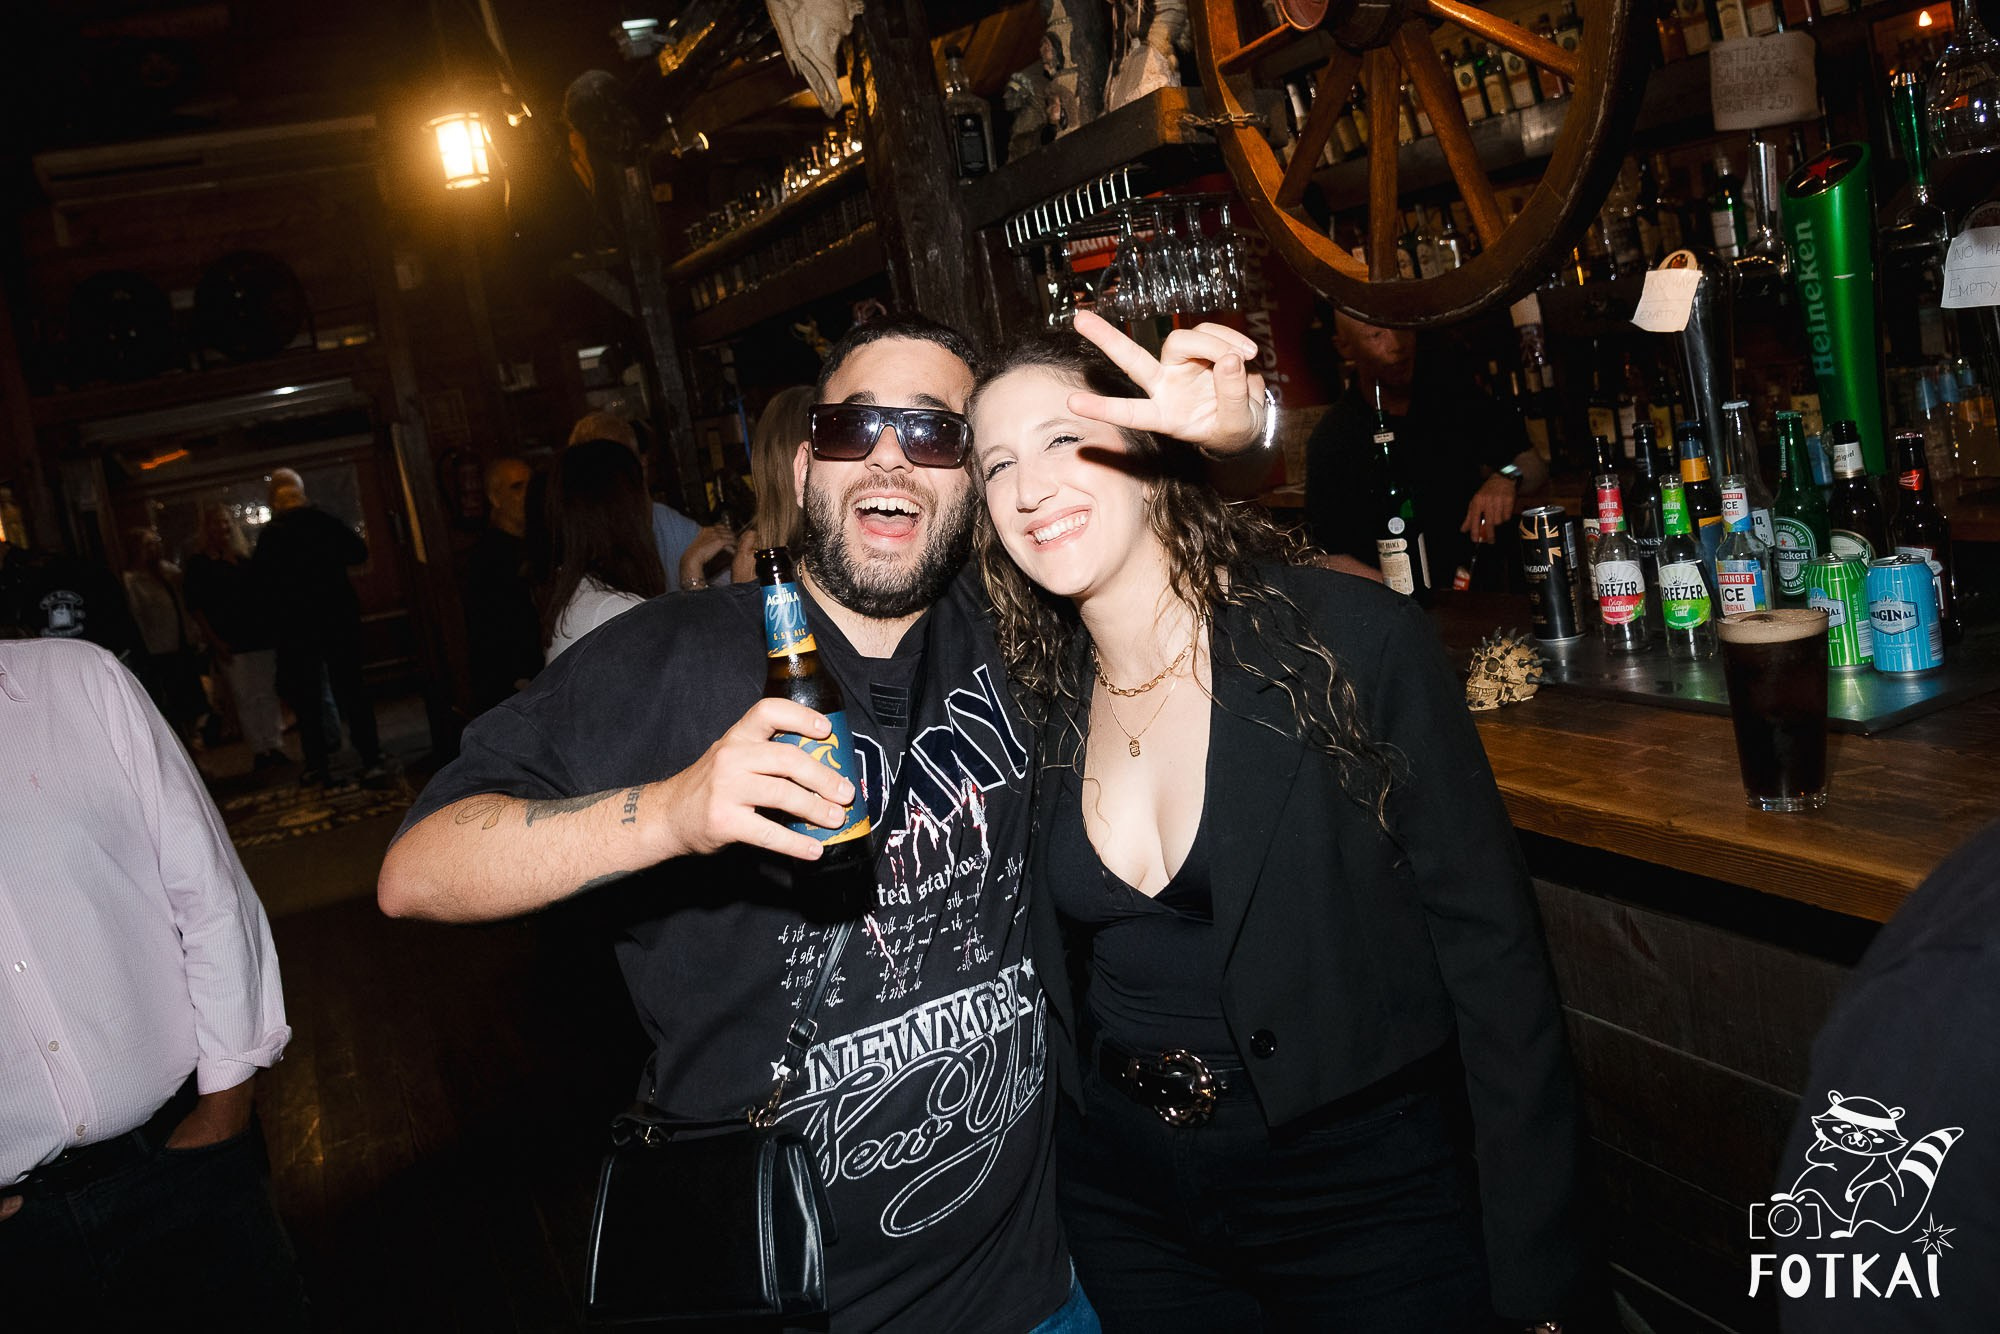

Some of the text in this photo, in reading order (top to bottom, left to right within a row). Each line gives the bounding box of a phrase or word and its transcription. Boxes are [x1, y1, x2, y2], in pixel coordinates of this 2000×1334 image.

[1953, 243, 2000, 261] NO HA
[1795, 218, 1836, 377] Heineken
[1948, 278, 1998, 299] EMPTY
[1598, 581, 1638, 598] REEZER
[1722, 587, 1747, 602] ICE
[877, 880, 912, 907] ted
